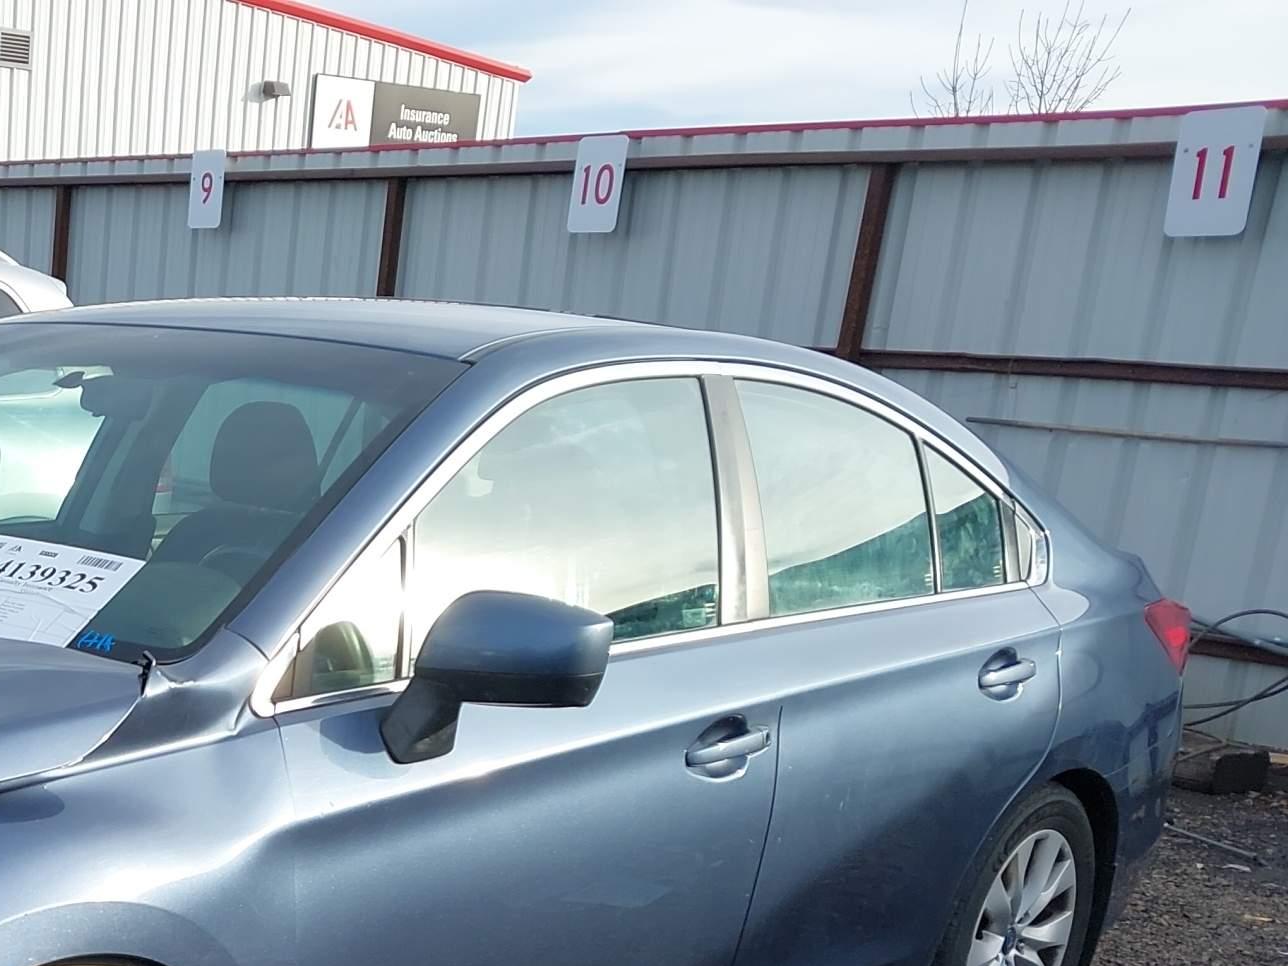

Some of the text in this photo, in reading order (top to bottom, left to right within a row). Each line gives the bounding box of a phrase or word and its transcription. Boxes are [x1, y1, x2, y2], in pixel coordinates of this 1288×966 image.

[400, 104, 450, 125] Insurance
[388, 122, 458, 143] Auto Auctions
[201, 172, 213, 204] 9
[581, 164, 615, 205] 10
[1192, 145, 1235, 200] 11
